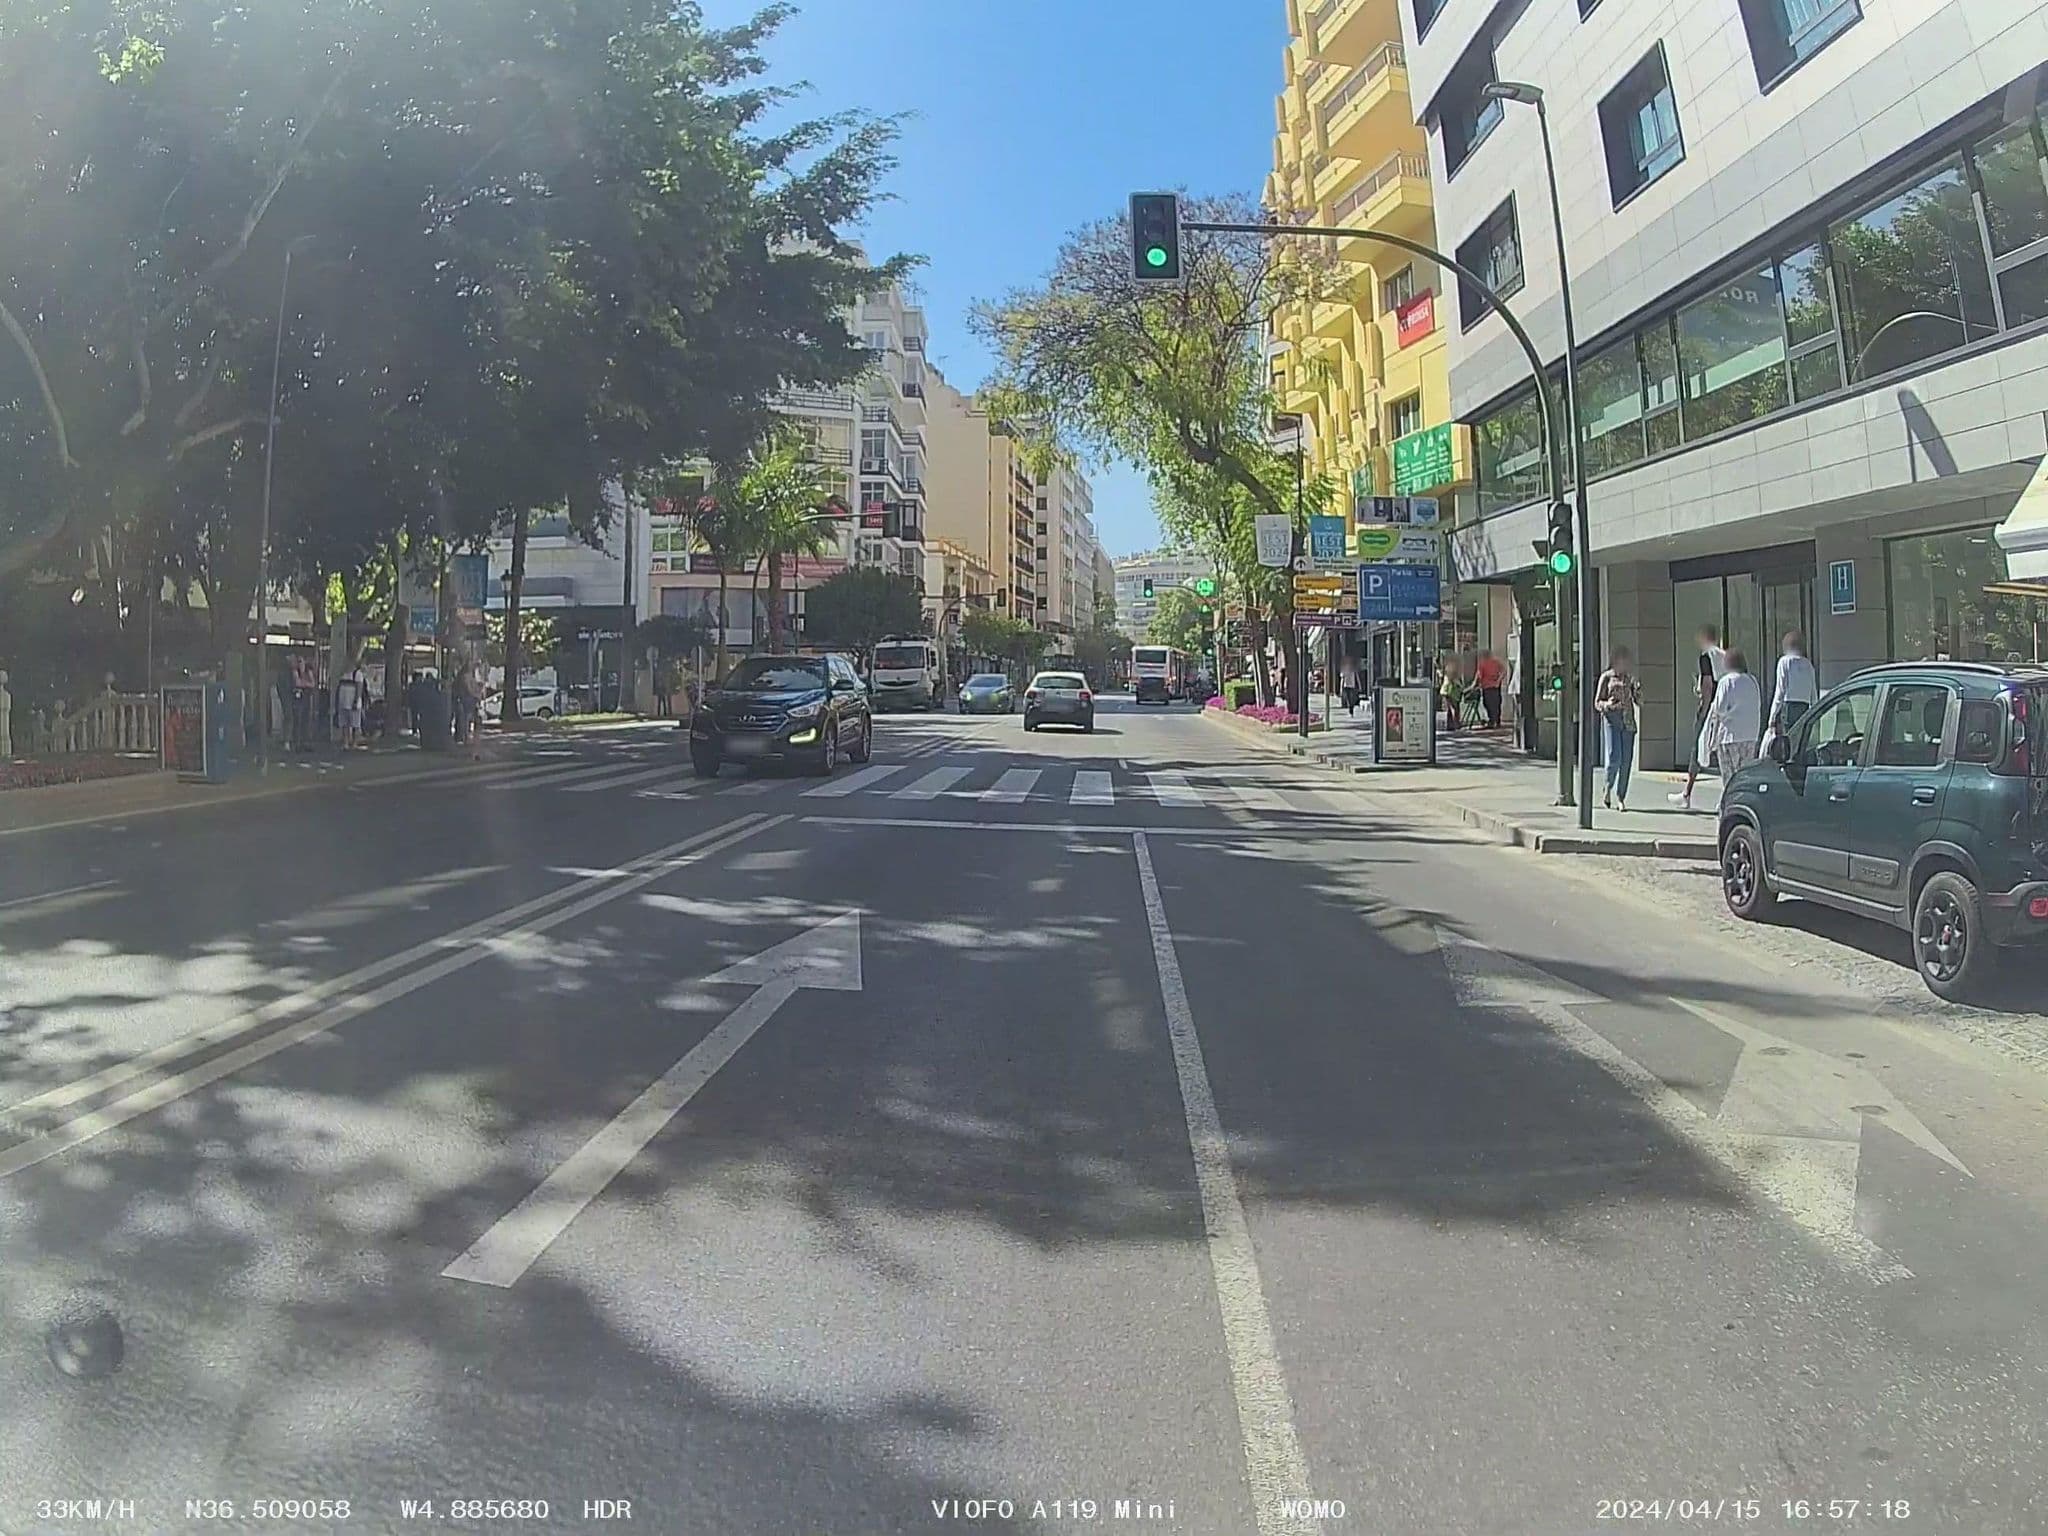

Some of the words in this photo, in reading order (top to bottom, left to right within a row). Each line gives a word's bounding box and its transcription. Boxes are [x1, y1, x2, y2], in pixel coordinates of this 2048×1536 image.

[1263, 547, 1289, 558] 2024
[1369, 575, 1382, 594] P
[1837, 566, 1848, 590] H
